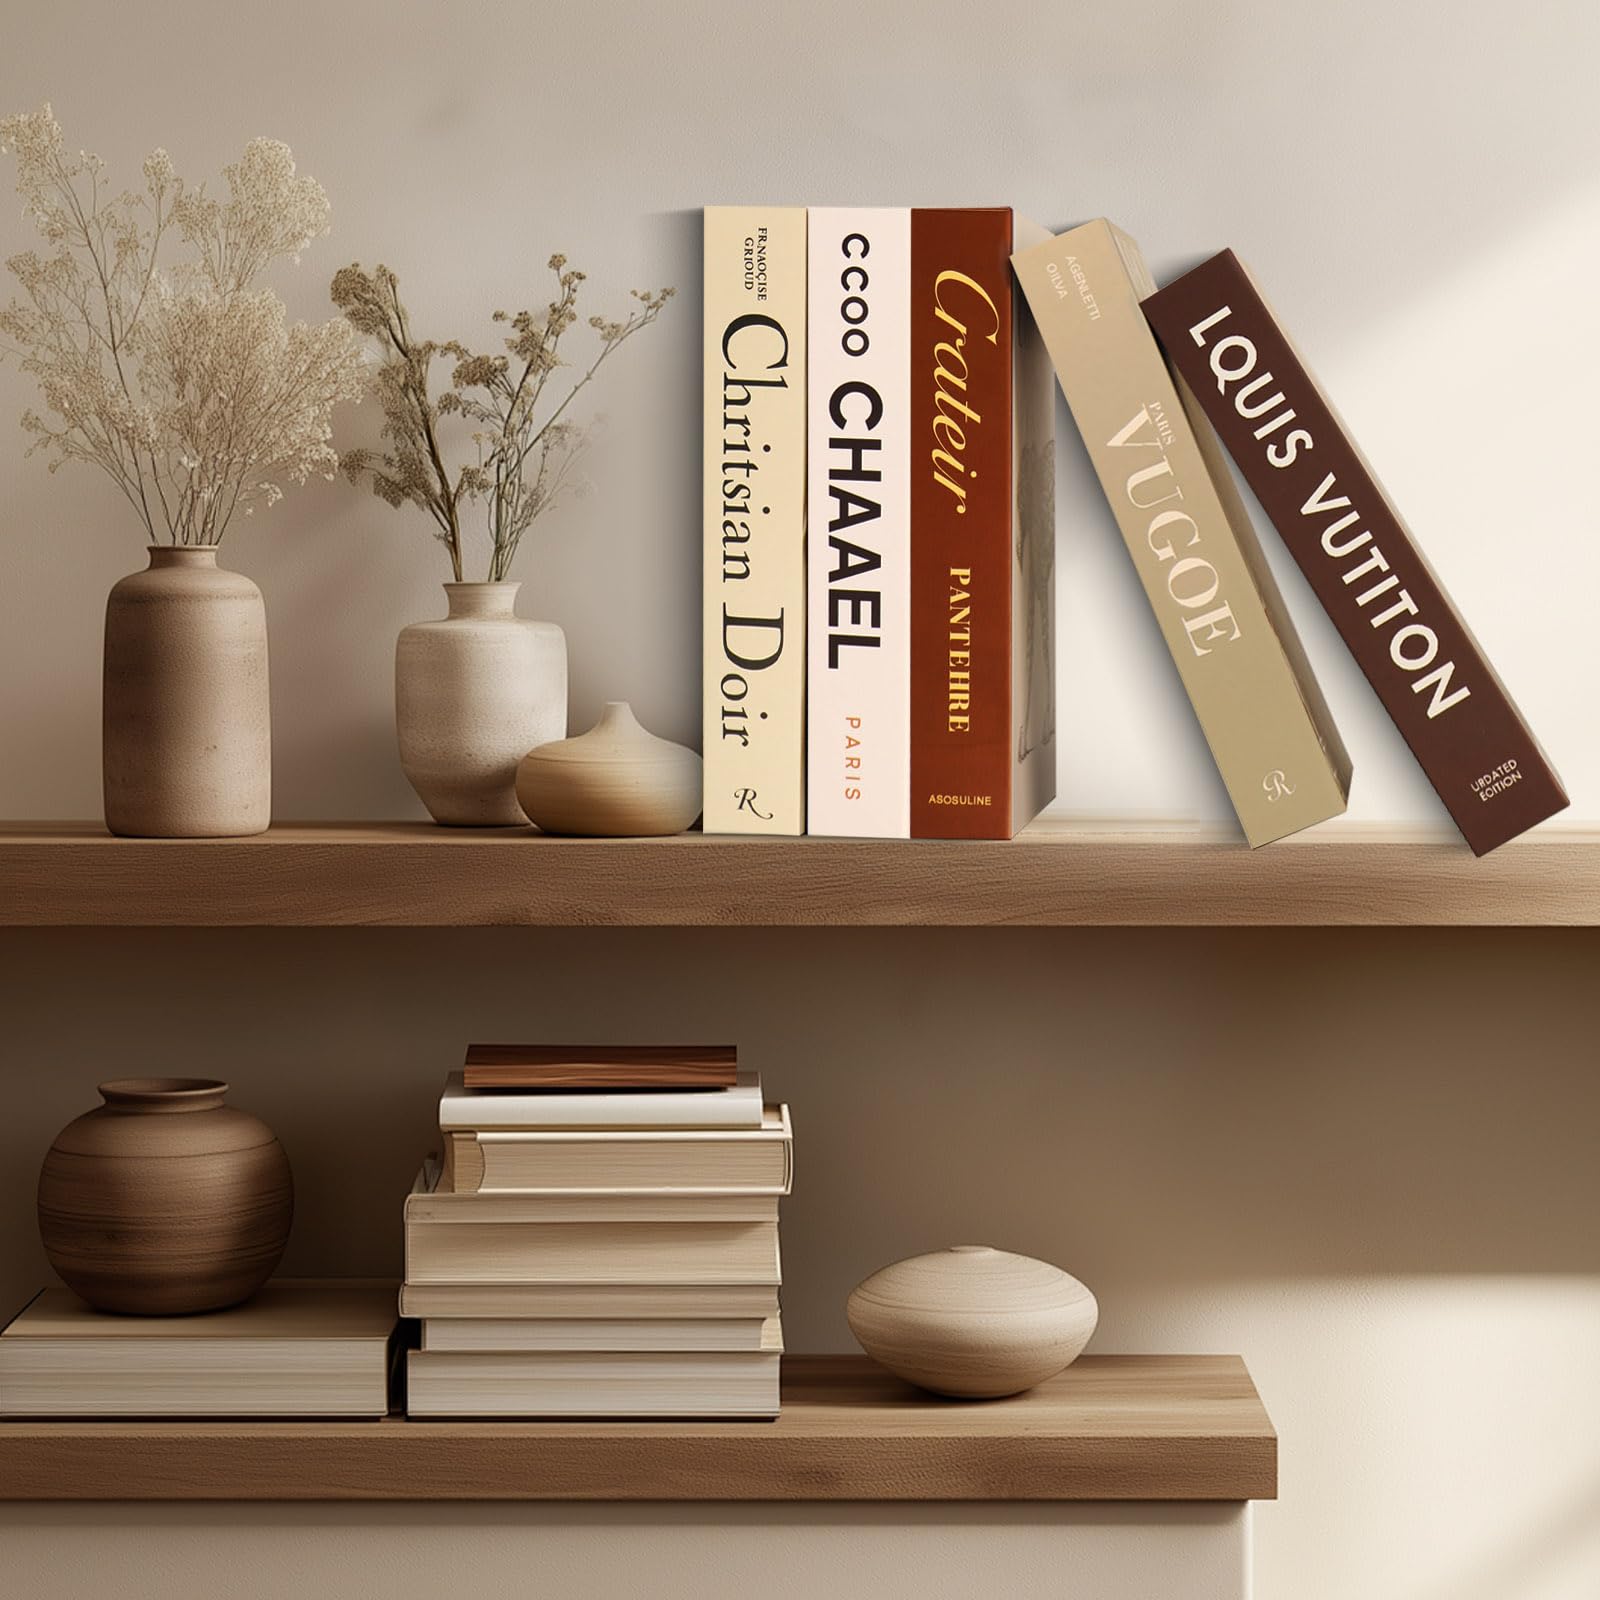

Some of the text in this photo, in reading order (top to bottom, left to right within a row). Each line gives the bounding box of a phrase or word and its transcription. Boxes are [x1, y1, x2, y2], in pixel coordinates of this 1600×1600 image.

[743, 236, 755, 291] GRIOUD
[932, 269, 1000, 514] Crateir
[1149, 401, 1176, 446] PARIS
[721, 313, 790, 748] Chritsian Doir
[828, 380, 884, 670] CHAAEL
[1106, 403, 1242, 657] VUGOE
[1189, 305, 1472, 720] LQUIS VUTITON
[948, 567, 972, 732] PANTEHRE
[845, 716, 862, 800] PARIS
[928, 794, 992, 806] ASOSULINE
